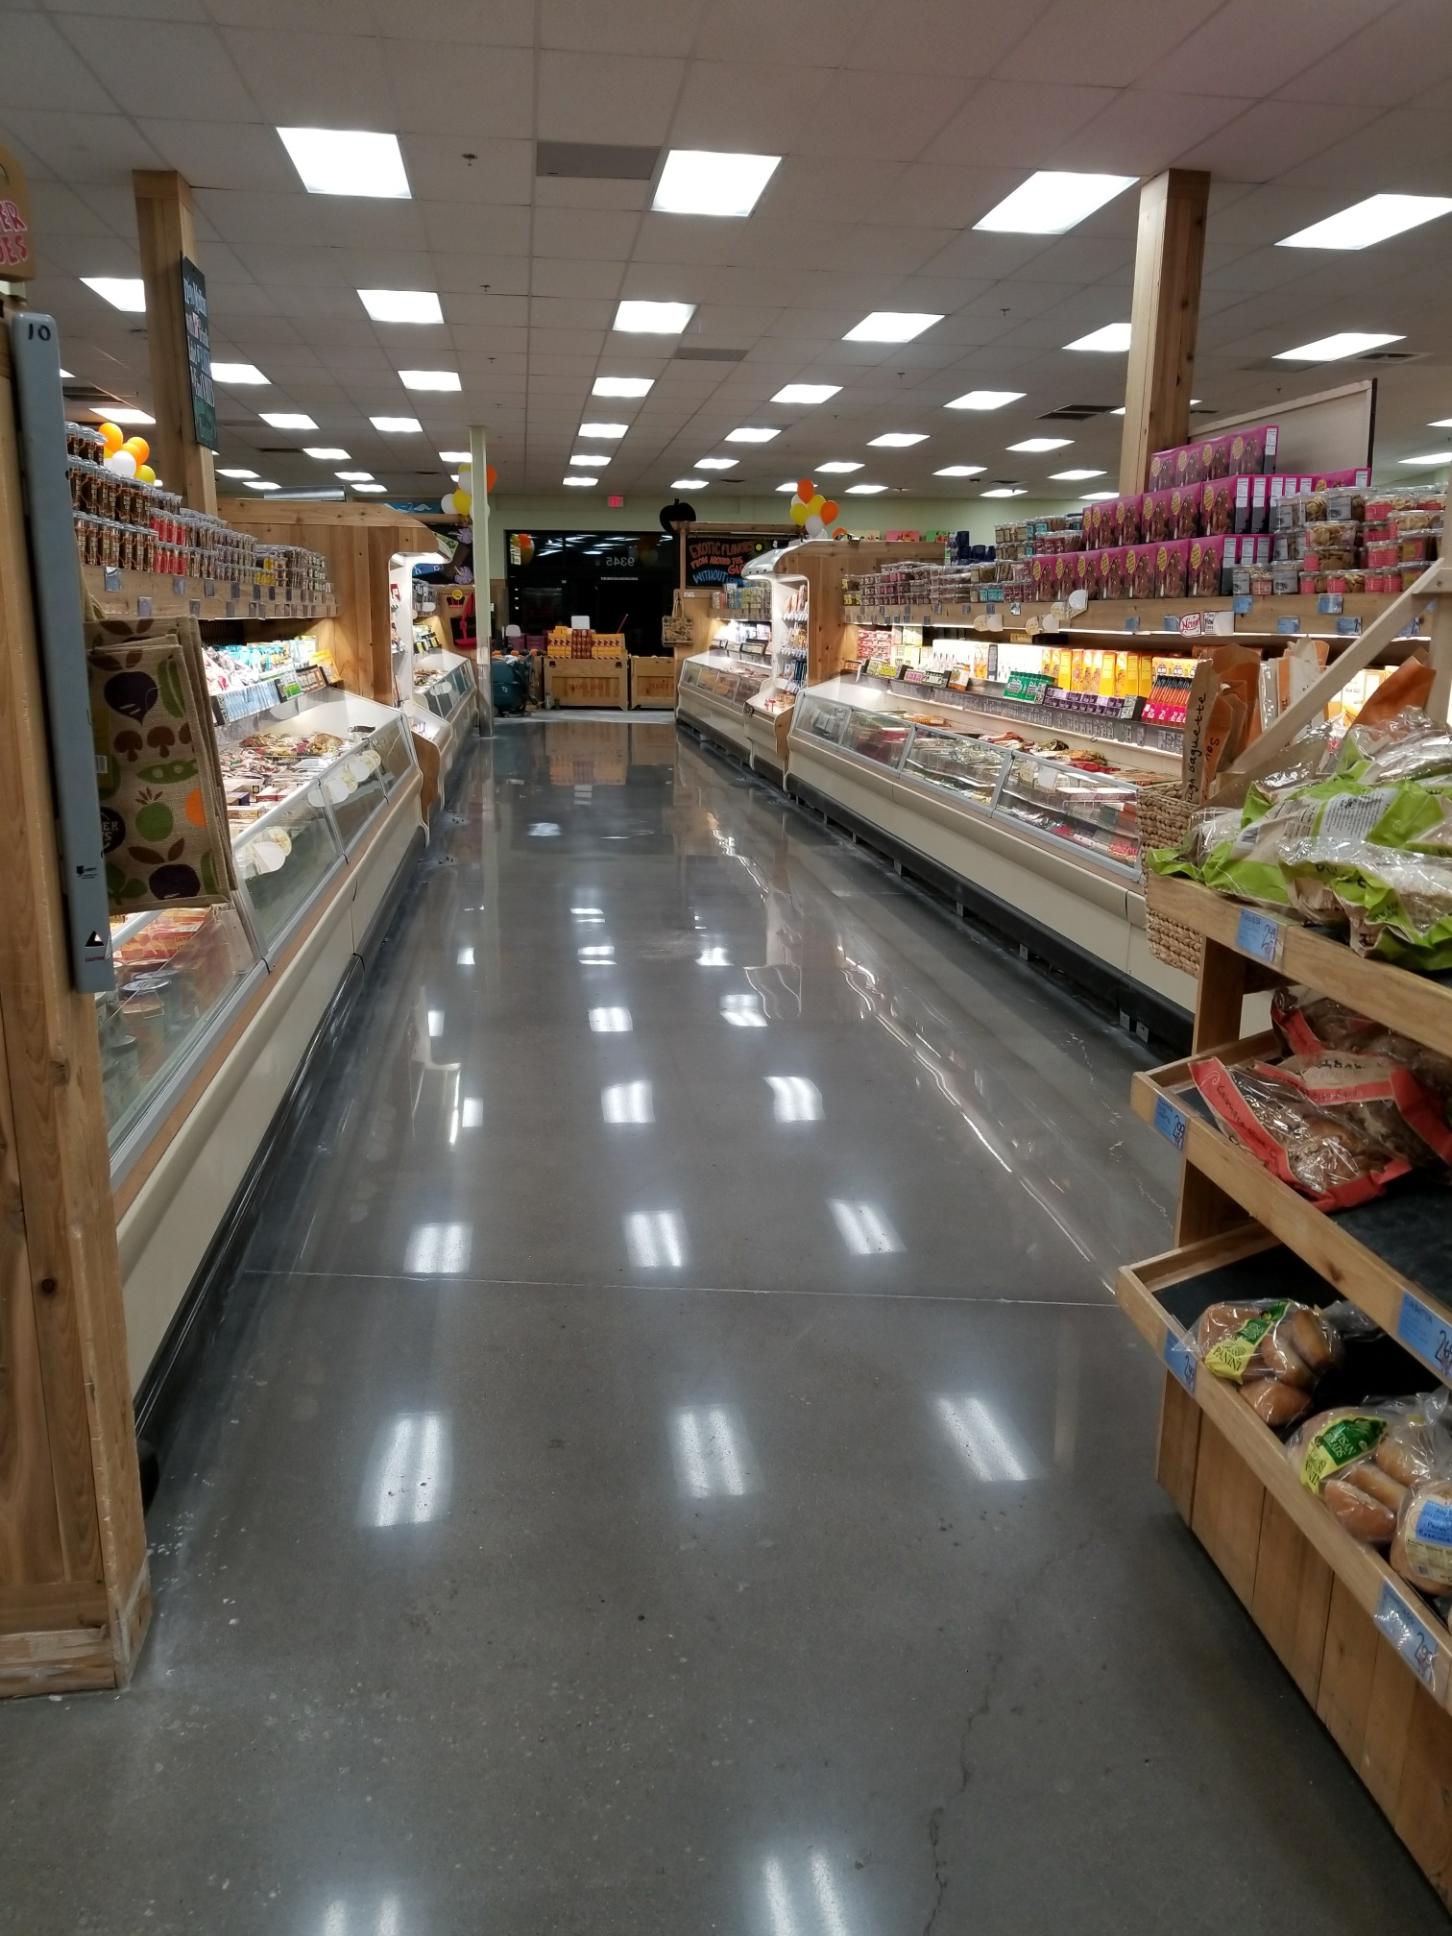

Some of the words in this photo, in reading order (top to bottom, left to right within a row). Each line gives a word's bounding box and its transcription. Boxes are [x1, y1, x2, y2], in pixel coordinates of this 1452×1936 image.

[27, 323, 52, 341] 10
[692, 569, 728, 585] WITHOUT
[1212, 1346, 1242, 1372] PANINI
